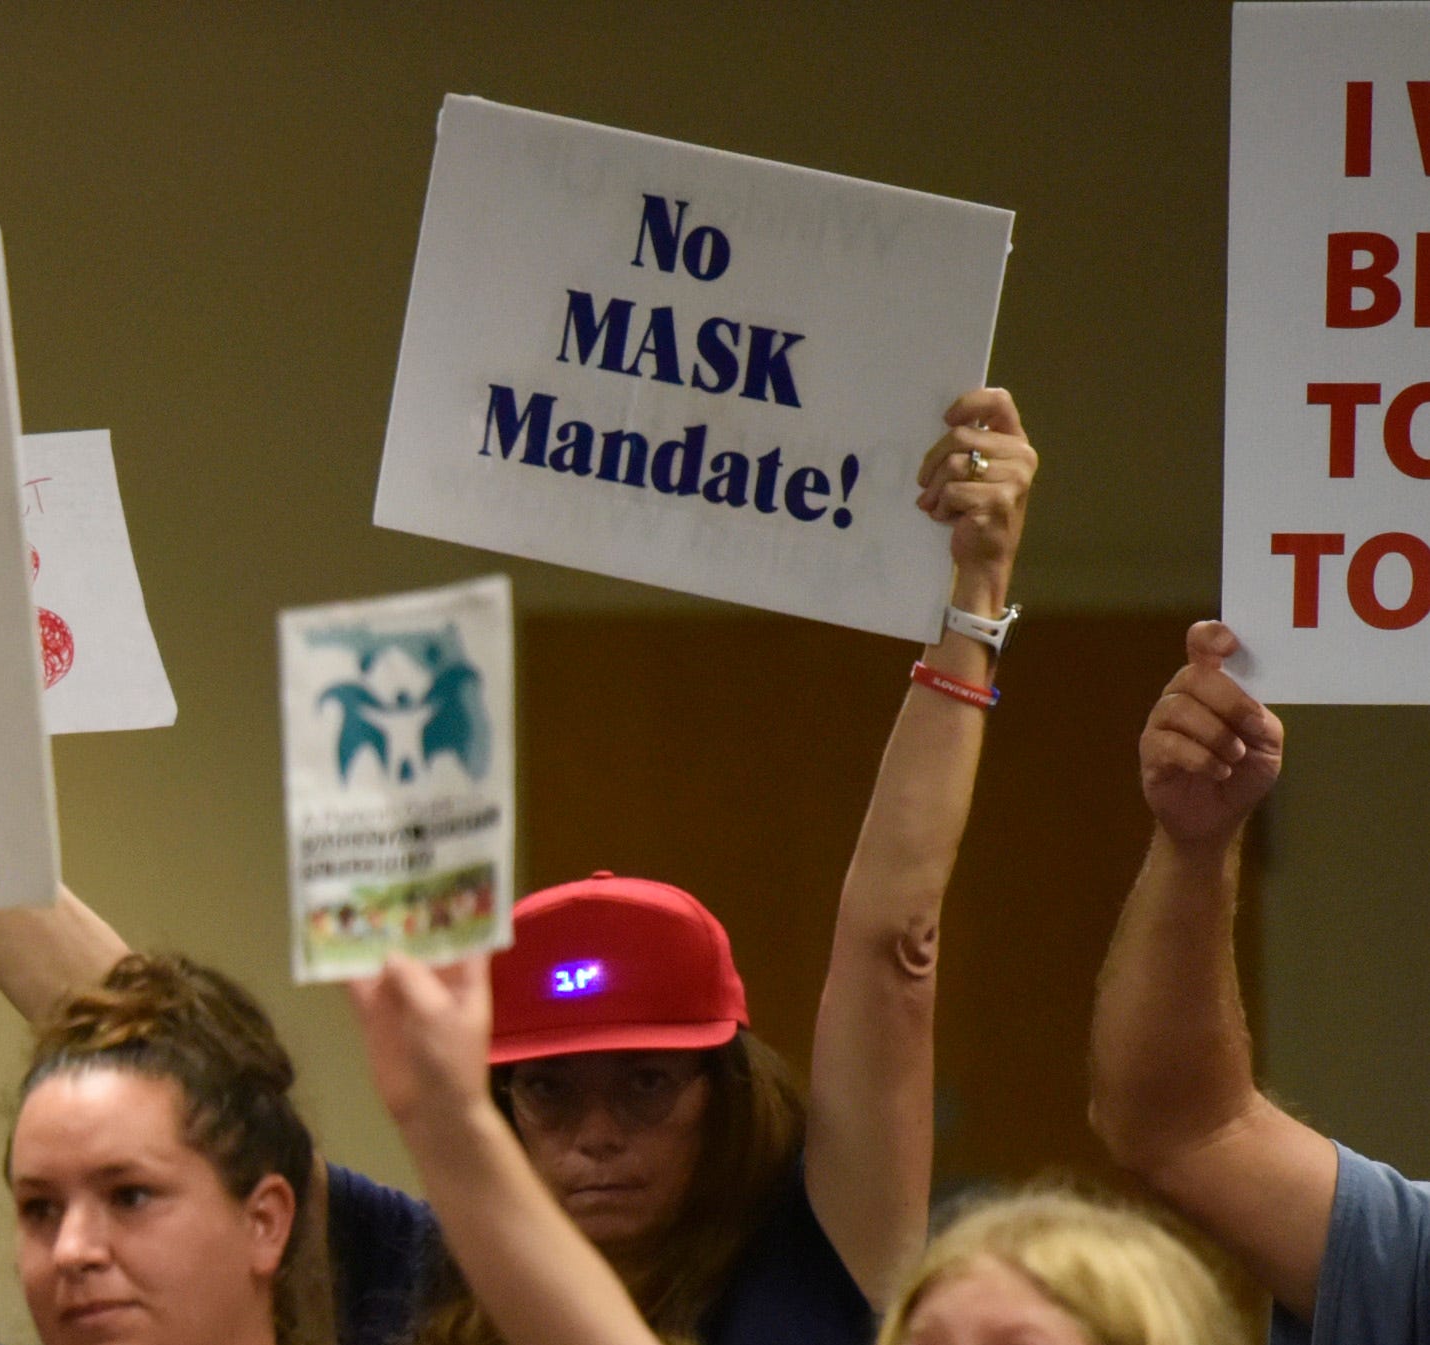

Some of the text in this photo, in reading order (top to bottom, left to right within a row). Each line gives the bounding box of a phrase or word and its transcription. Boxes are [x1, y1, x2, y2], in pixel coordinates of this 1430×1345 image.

[1345, 81, 1373, 177] I
[630, 193, 731, 282] No
[556, 289, 805, 409] MASK
[478, 383, 860, 530] Mandate!
